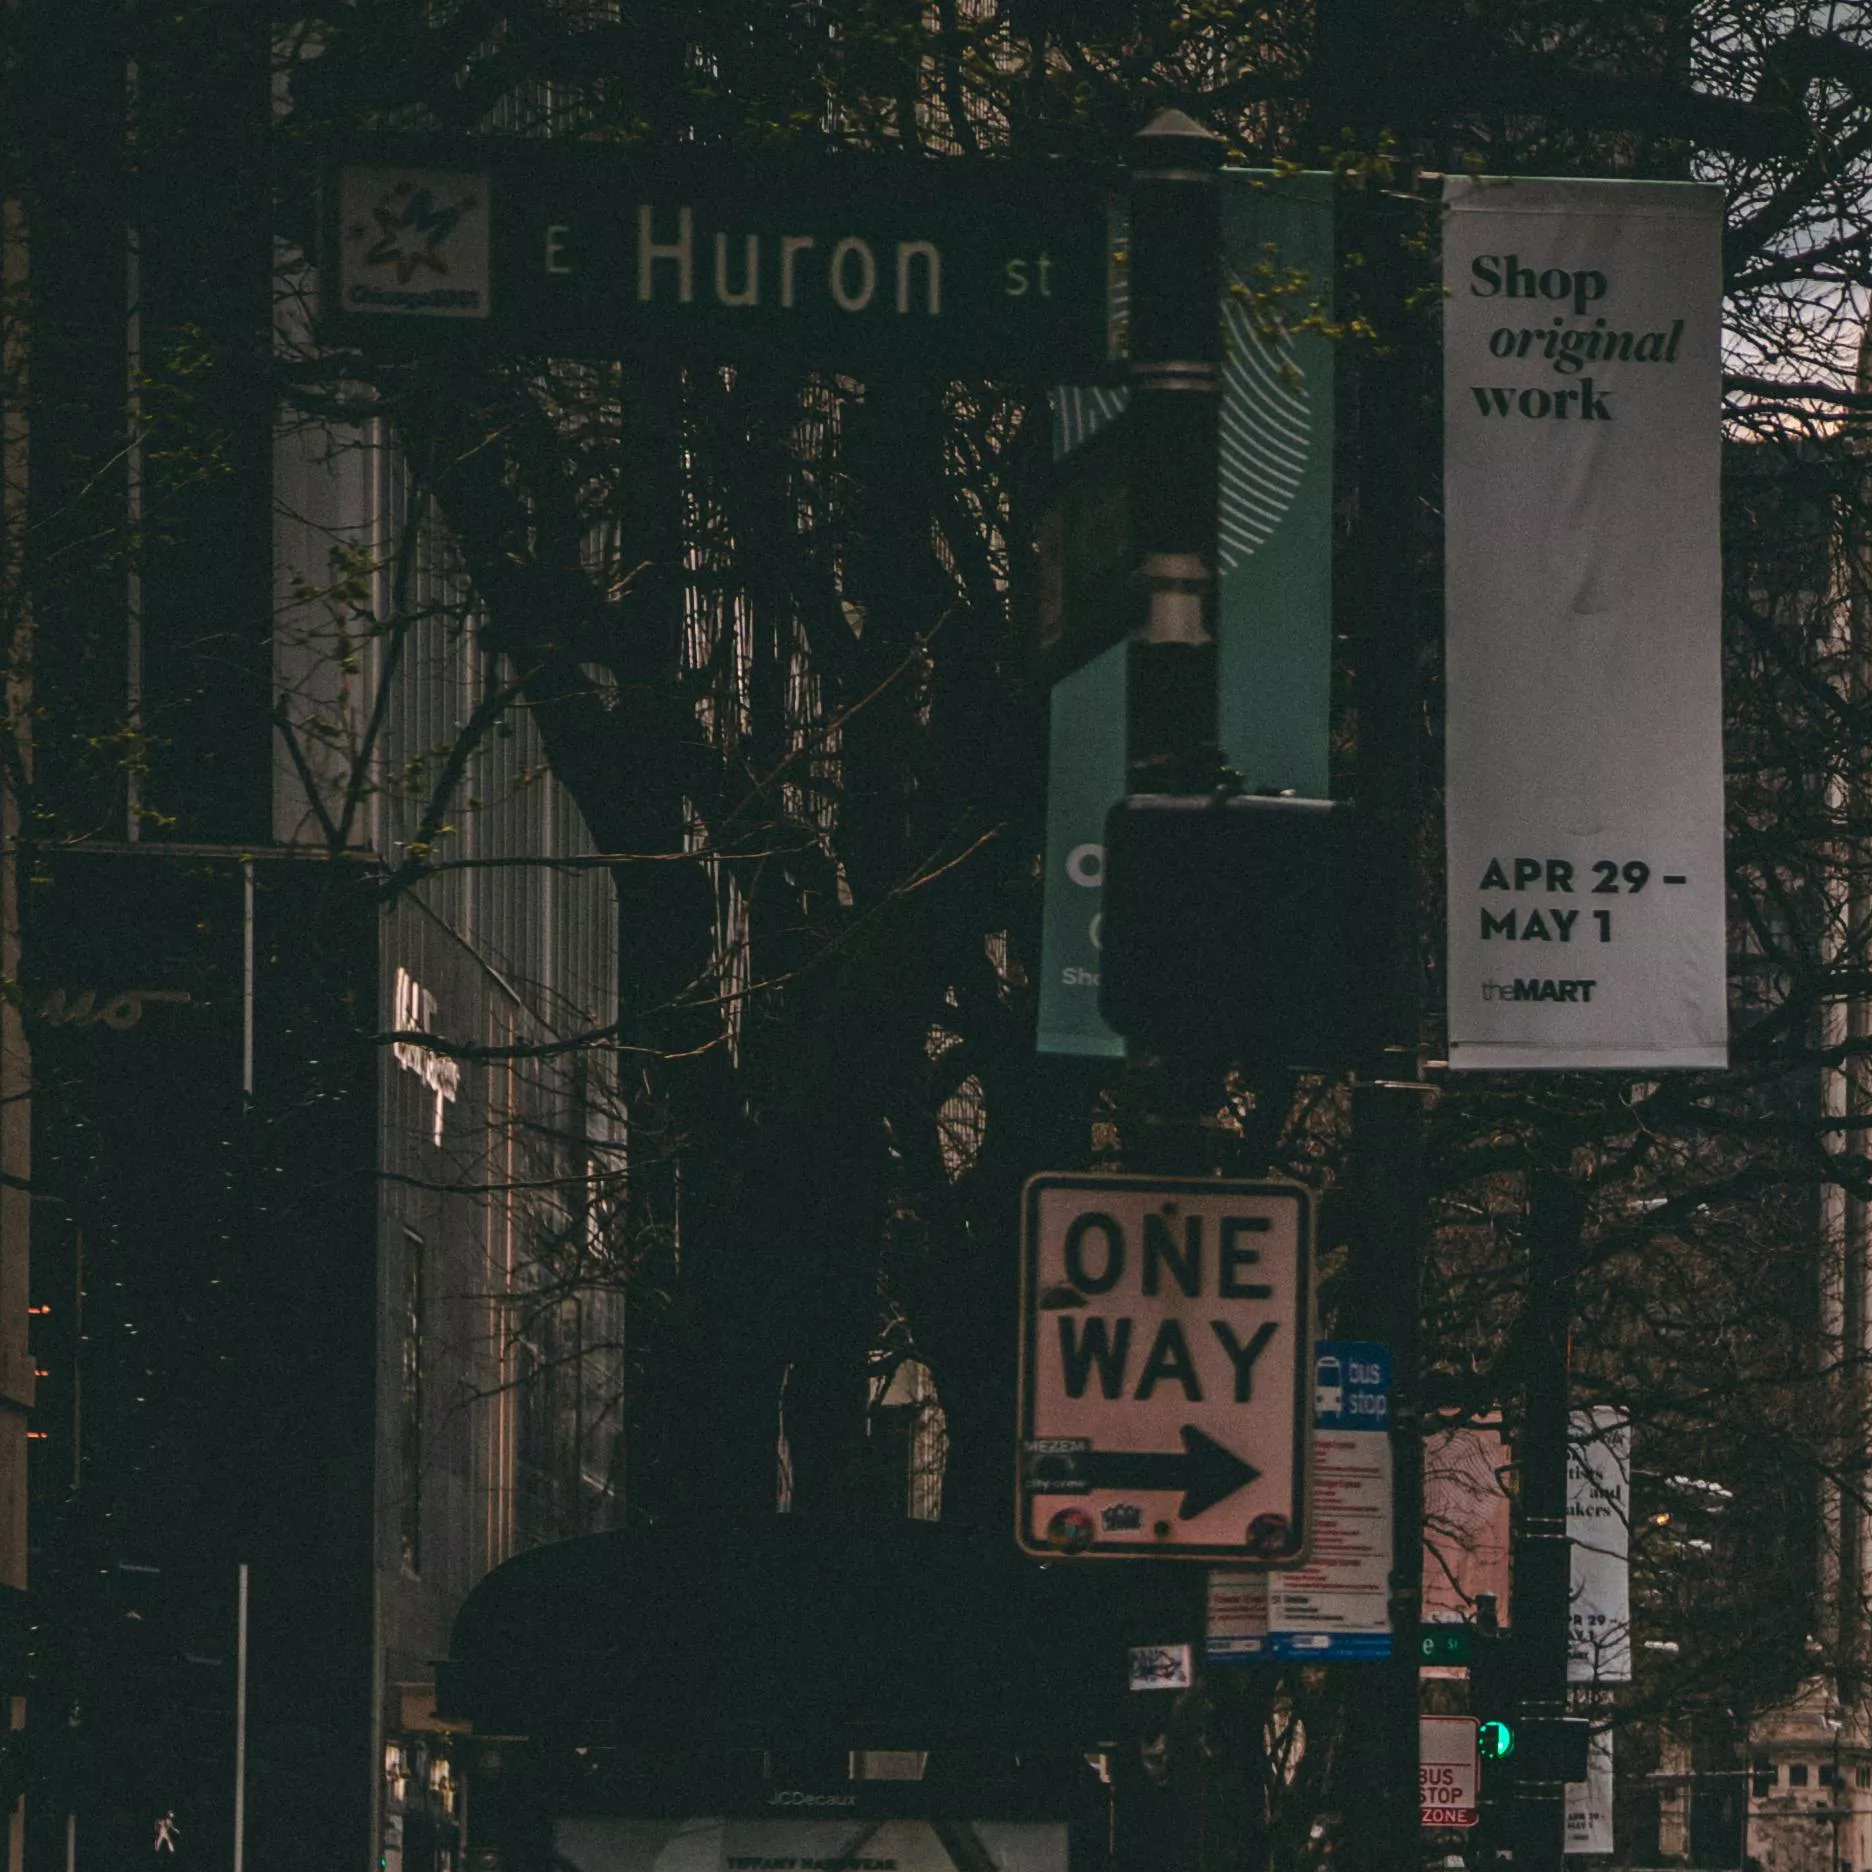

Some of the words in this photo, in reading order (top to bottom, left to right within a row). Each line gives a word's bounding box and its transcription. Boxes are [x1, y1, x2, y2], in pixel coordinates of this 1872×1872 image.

[549, 225, 574, 273] E
[637, 205, 940, 315] Huron
[1005, 247, 1053, 297] st
[1469, 255, 1605, 315] Shop
[1487, 319, 1685, 374] original
[1469, 380, 1613, 422] work
[1478, 858, 1574, 894] APR
[1589, 860, 1651, 894] 29
[1479, 908, 1580, 943] MAY
[1595, 908, 1611, 943] 1
[1480, 977, 1595, 1002] theMART
[1064, 1211, 1272, 1299] ONE
[1057, 1316, 1280, 1402] WAY
[1349, 1363, 1382, 1385] bus
[1349, 1391, 1388, 1420] stop
[1567, 1502, 1611, 1517] akers
[1420, 1768, 1455, 1785] BUS
[1422, 1808, 1468, 1822] ZONE
